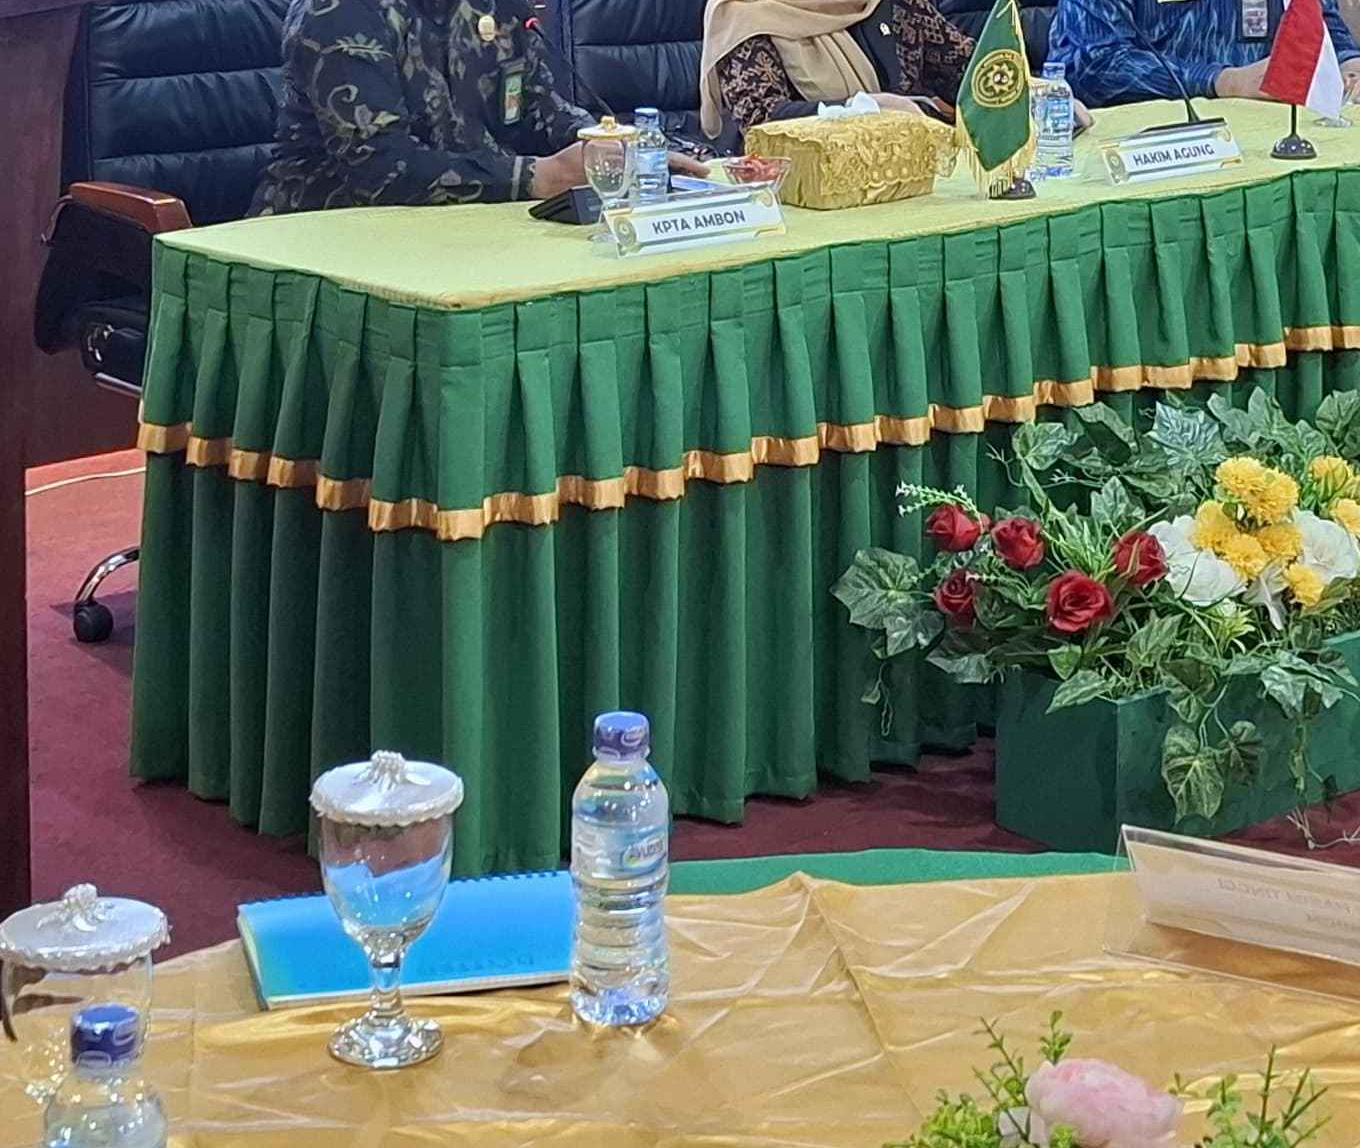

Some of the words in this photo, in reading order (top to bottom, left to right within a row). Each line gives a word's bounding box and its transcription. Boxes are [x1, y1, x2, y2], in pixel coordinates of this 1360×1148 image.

[1132, 150, 1173, 167] HAKIM
[1174, 143, 1215, 161] AGUNG
[652, 217, 691, 234] KPTA
[694, 209, 746, 229] AMBON
